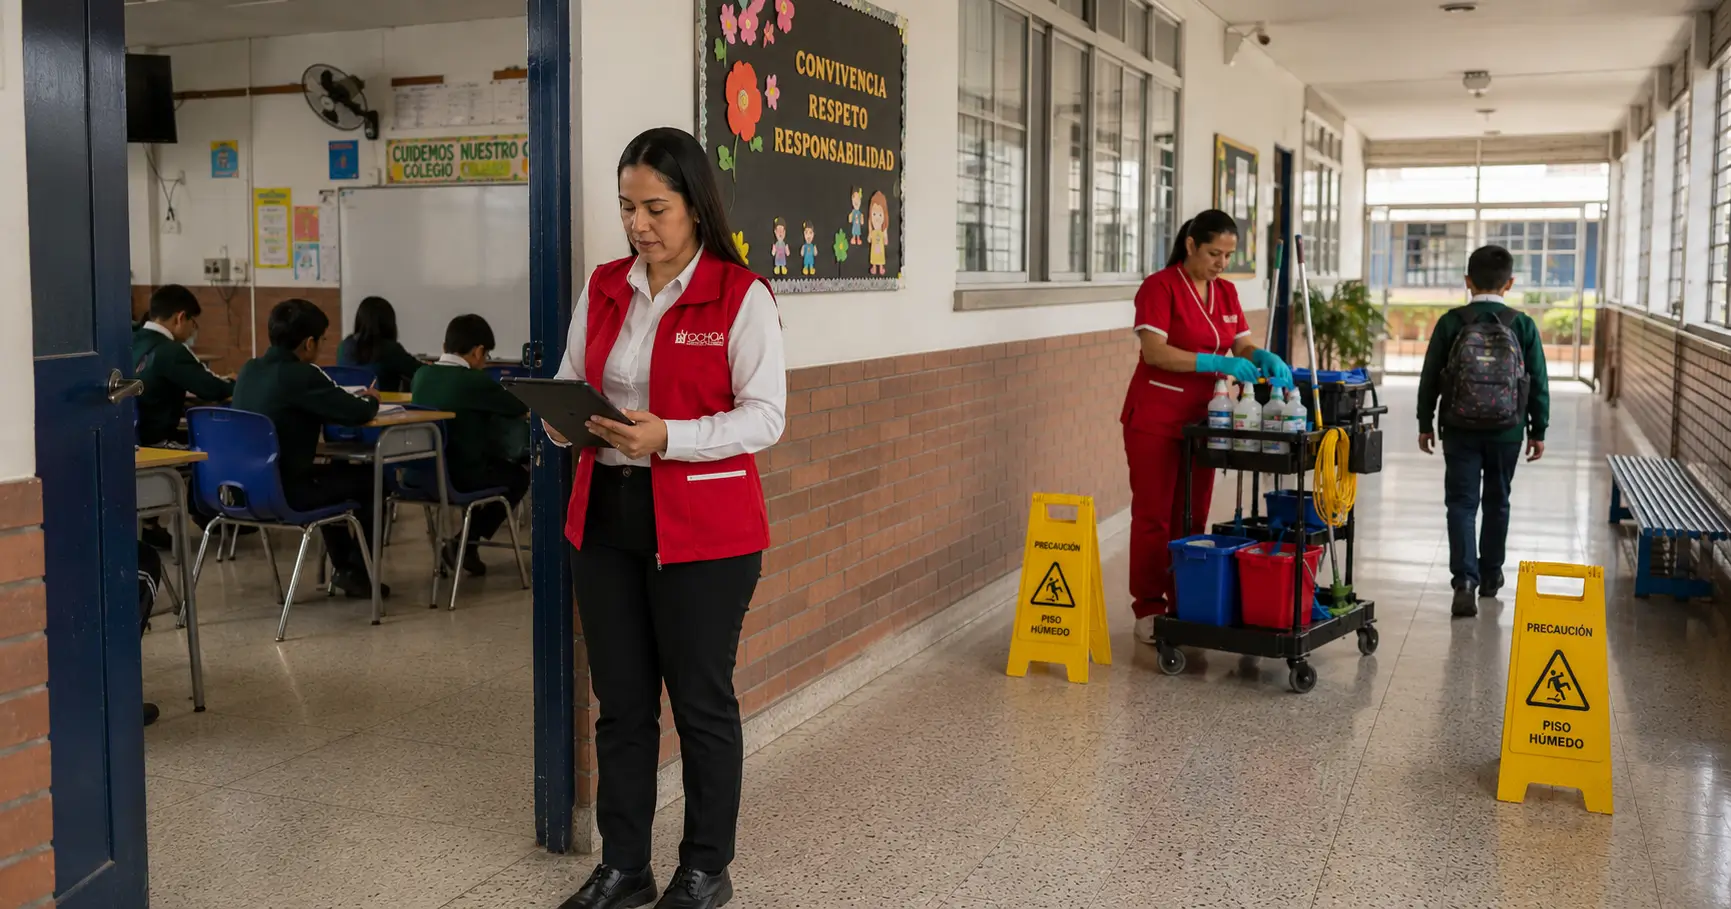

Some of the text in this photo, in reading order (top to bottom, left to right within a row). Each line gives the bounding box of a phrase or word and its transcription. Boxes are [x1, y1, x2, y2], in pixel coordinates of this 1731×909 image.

[795, 50, 888, 98] CONVIVENCIA
[808, 94, 868, 130] RESPETO
[392, 143, 454, 162] CUIDEMOS
[460, 141, 518, 160] NUESTRO
[774, 127, 895, 171] RESPONSABILIDAD
[403, 163, 453, 179] COLEGIO
[1034, 540, 1081, 552] PRECAUCIÓN
[1041, 614, 1062, 624] PISO
[1030, 624, 1070, 637] HÚMEDO
[1526, 622, 1593, 638] PRECAUCIÓN
[1542, 720, 1571, 733] PISO
[1529, 733, 1584, 750] HÚMEDO
